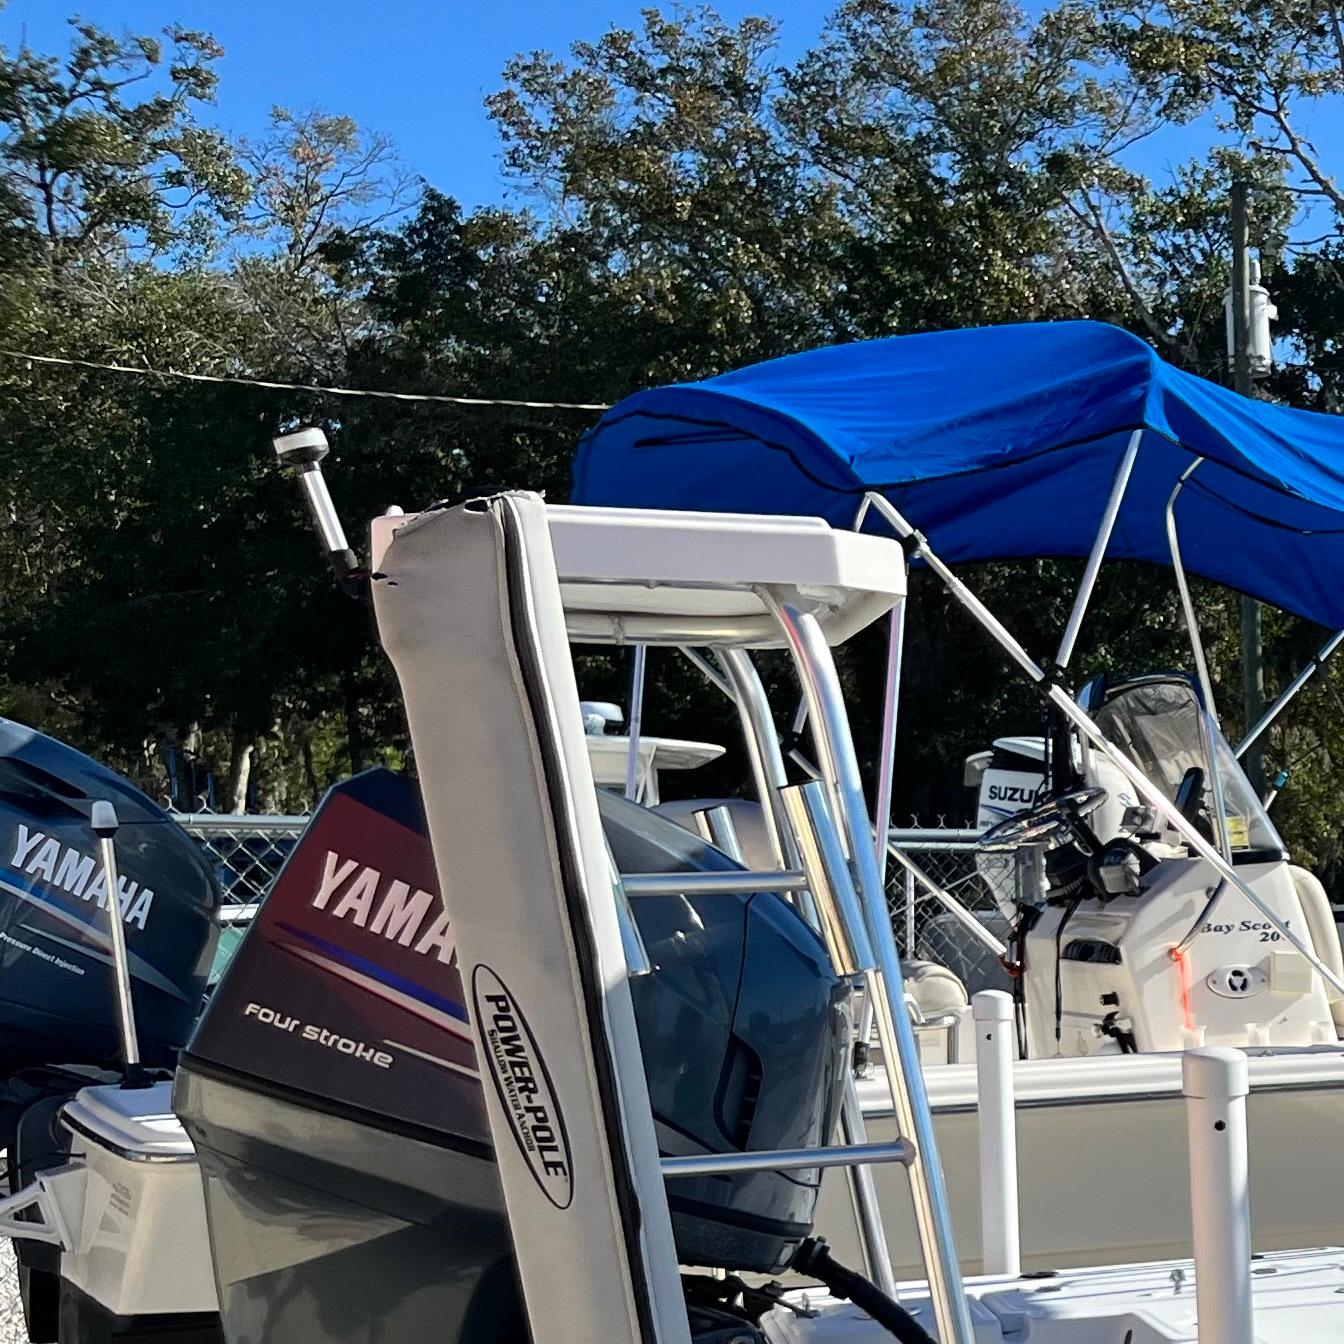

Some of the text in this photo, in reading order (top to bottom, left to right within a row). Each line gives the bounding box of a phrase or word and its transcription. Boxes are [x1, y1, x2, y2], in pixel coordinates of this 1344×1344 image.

[11, 824, 154, 930] YAMAHA
[313, 850, 459, 968] YAMA
[1201, 920, 1291, 935] Bay Scot
[485, 994, 567, 1177] POWER-POLE
